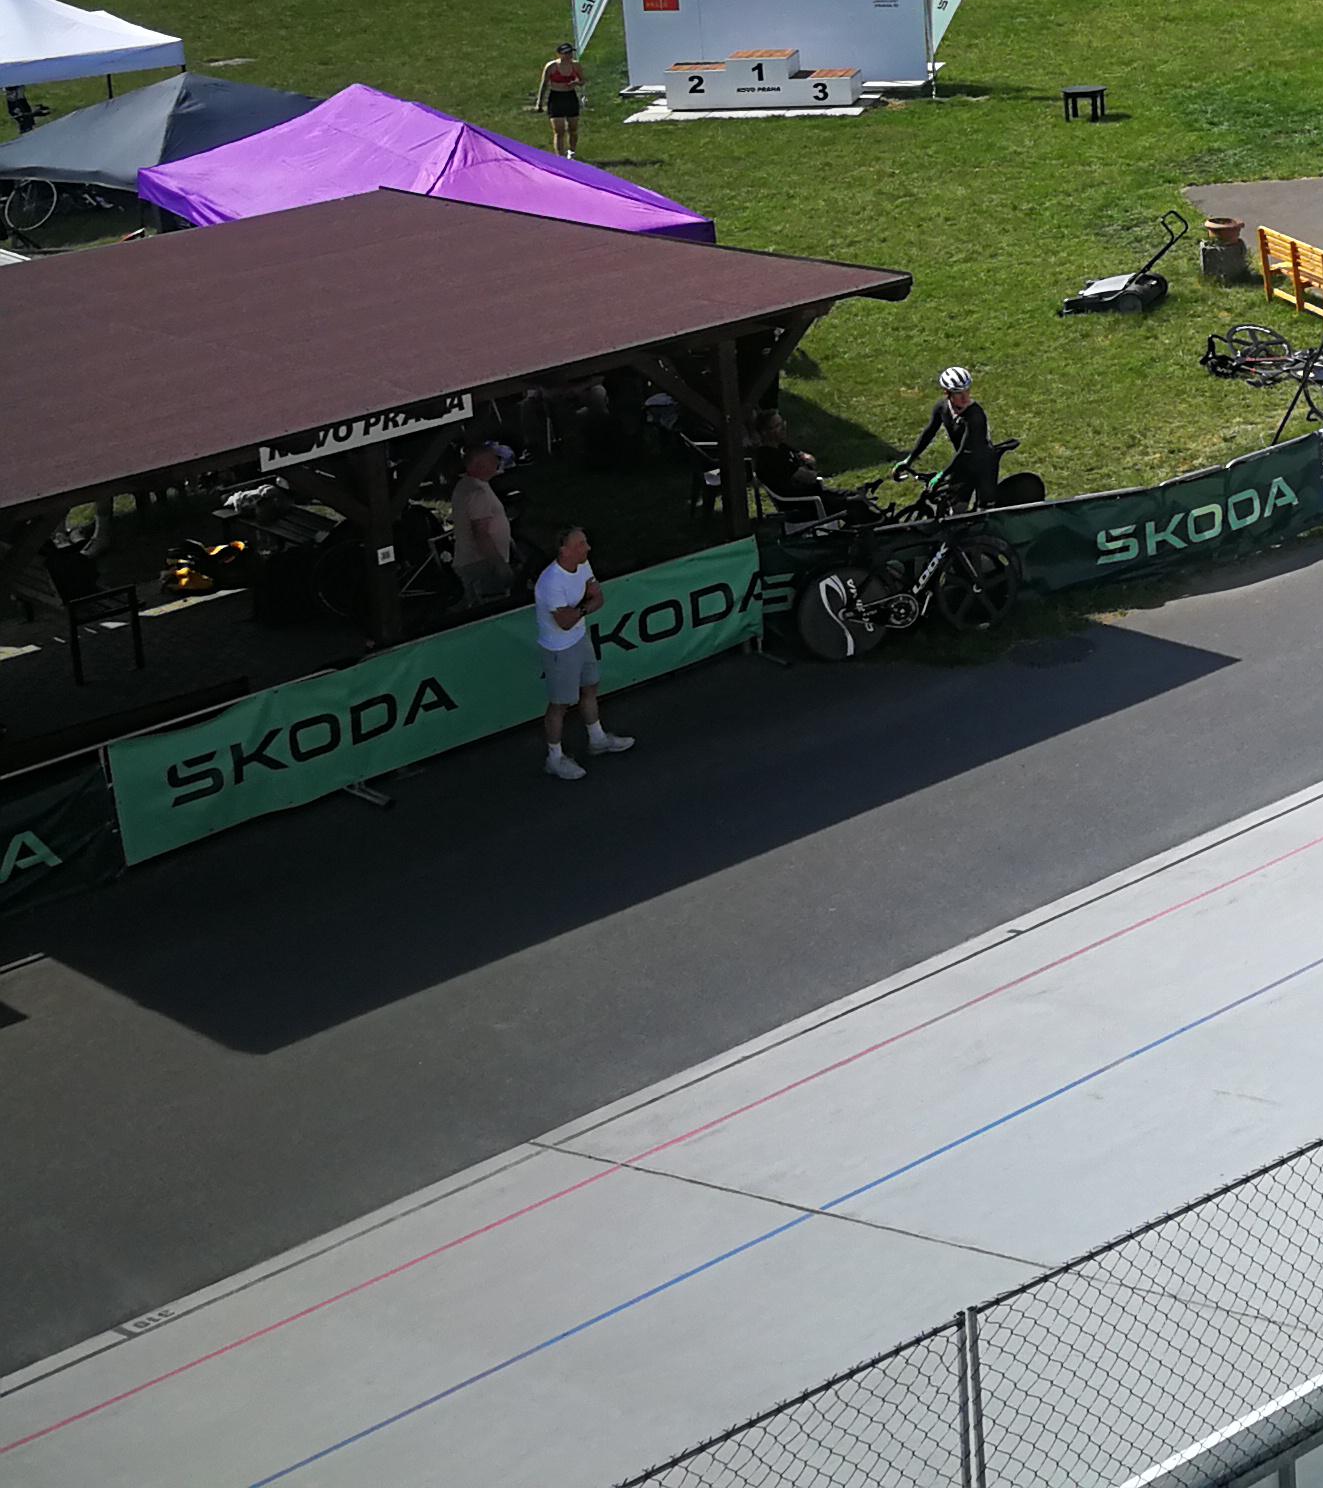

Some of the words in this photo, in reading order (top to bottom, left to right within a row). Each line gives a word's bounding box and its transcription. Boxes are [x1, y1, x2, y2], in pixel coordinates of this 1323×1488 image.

[751, 63, 764, 81] 1
[688, 75, 705, 94] 2
[812, 83, 829, 101] 3
[912, 541, 949, 594] LOOK
[590, 570, 763, 661] KODA
